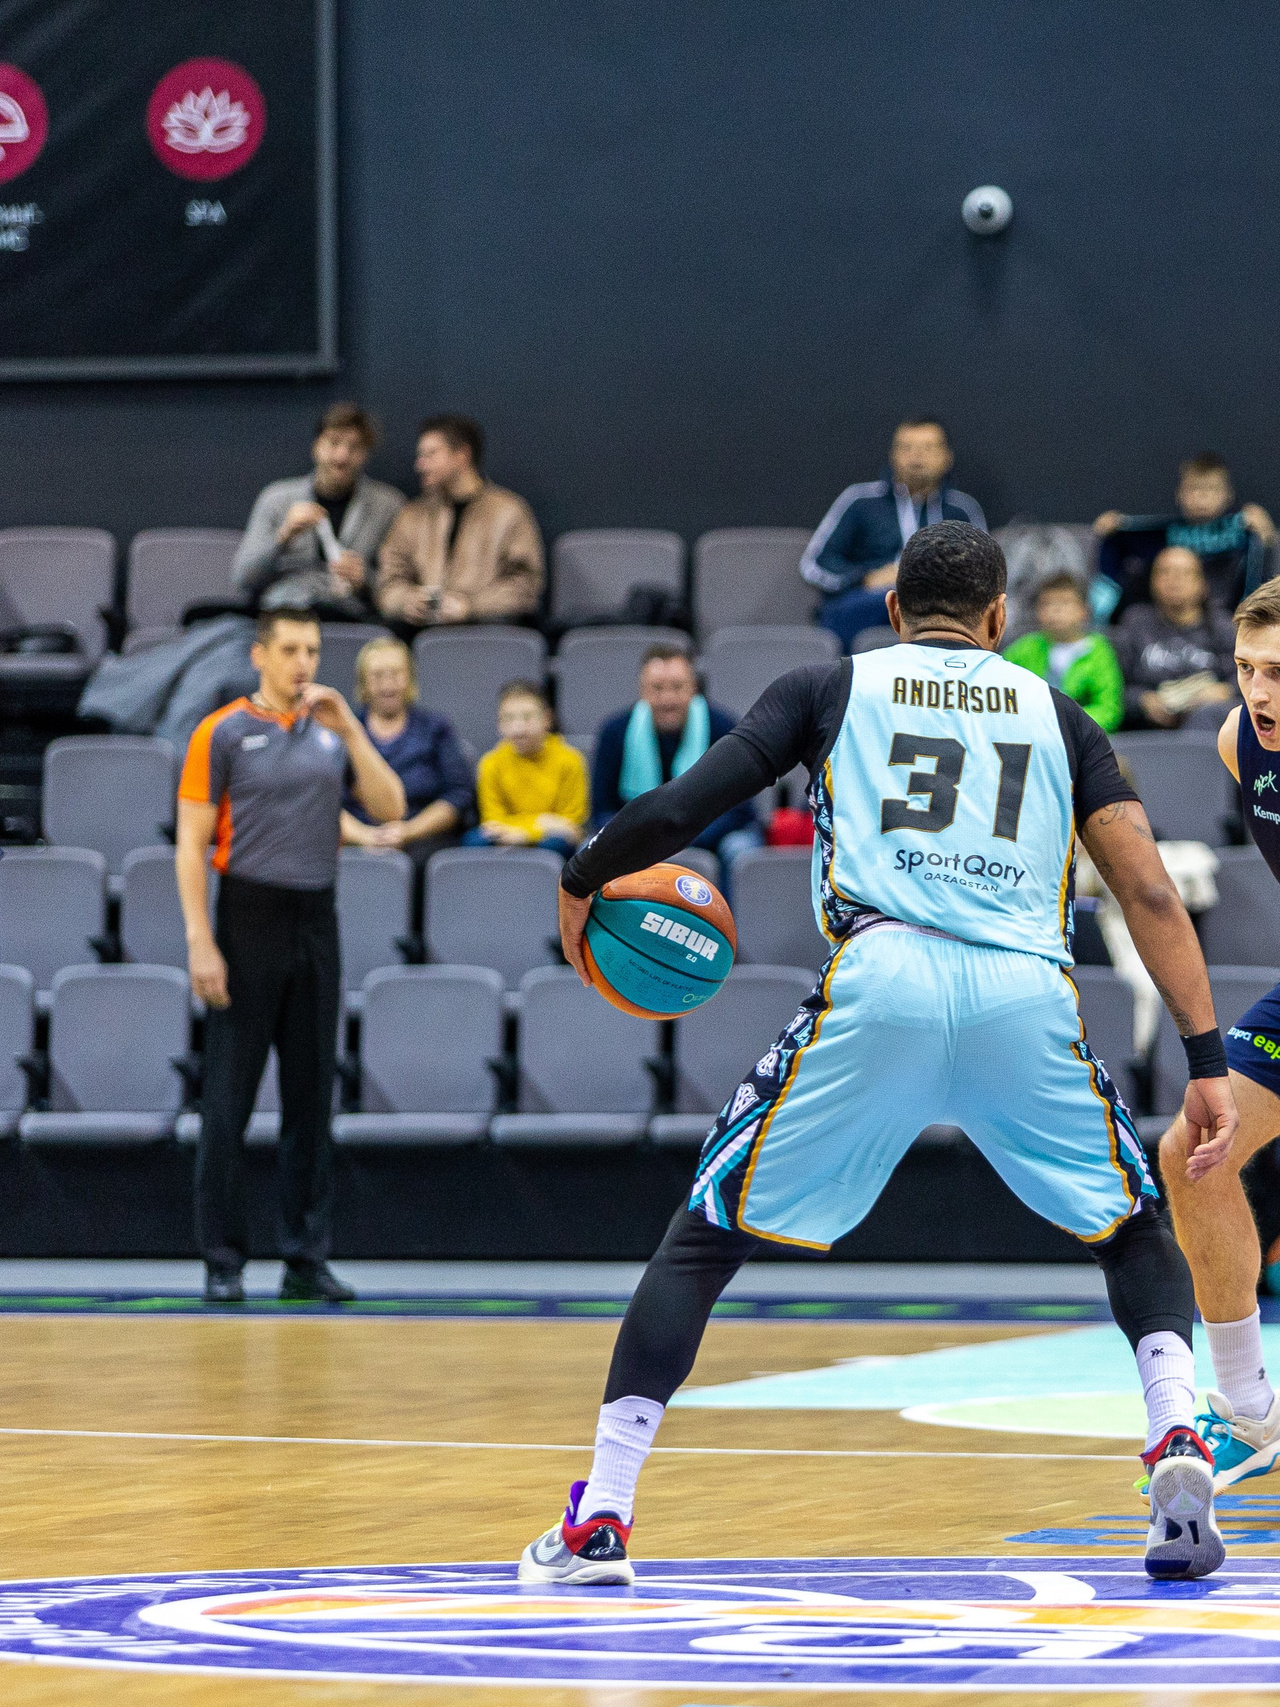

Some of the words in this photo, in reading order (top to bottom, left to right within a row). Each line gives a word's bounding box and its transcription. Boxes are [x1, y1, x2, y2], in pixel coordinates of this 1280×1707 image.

[892, 676, 1019, 715] ANDERSON
[880, 731, 1033, 843] 31
[893, 848, 1026, 888] SportQory
[923, 871, 999, 893] QAZAQSTAN
[640, 911, 719, 961] SIBUR
[685, 953, 698, 963] 2.0
